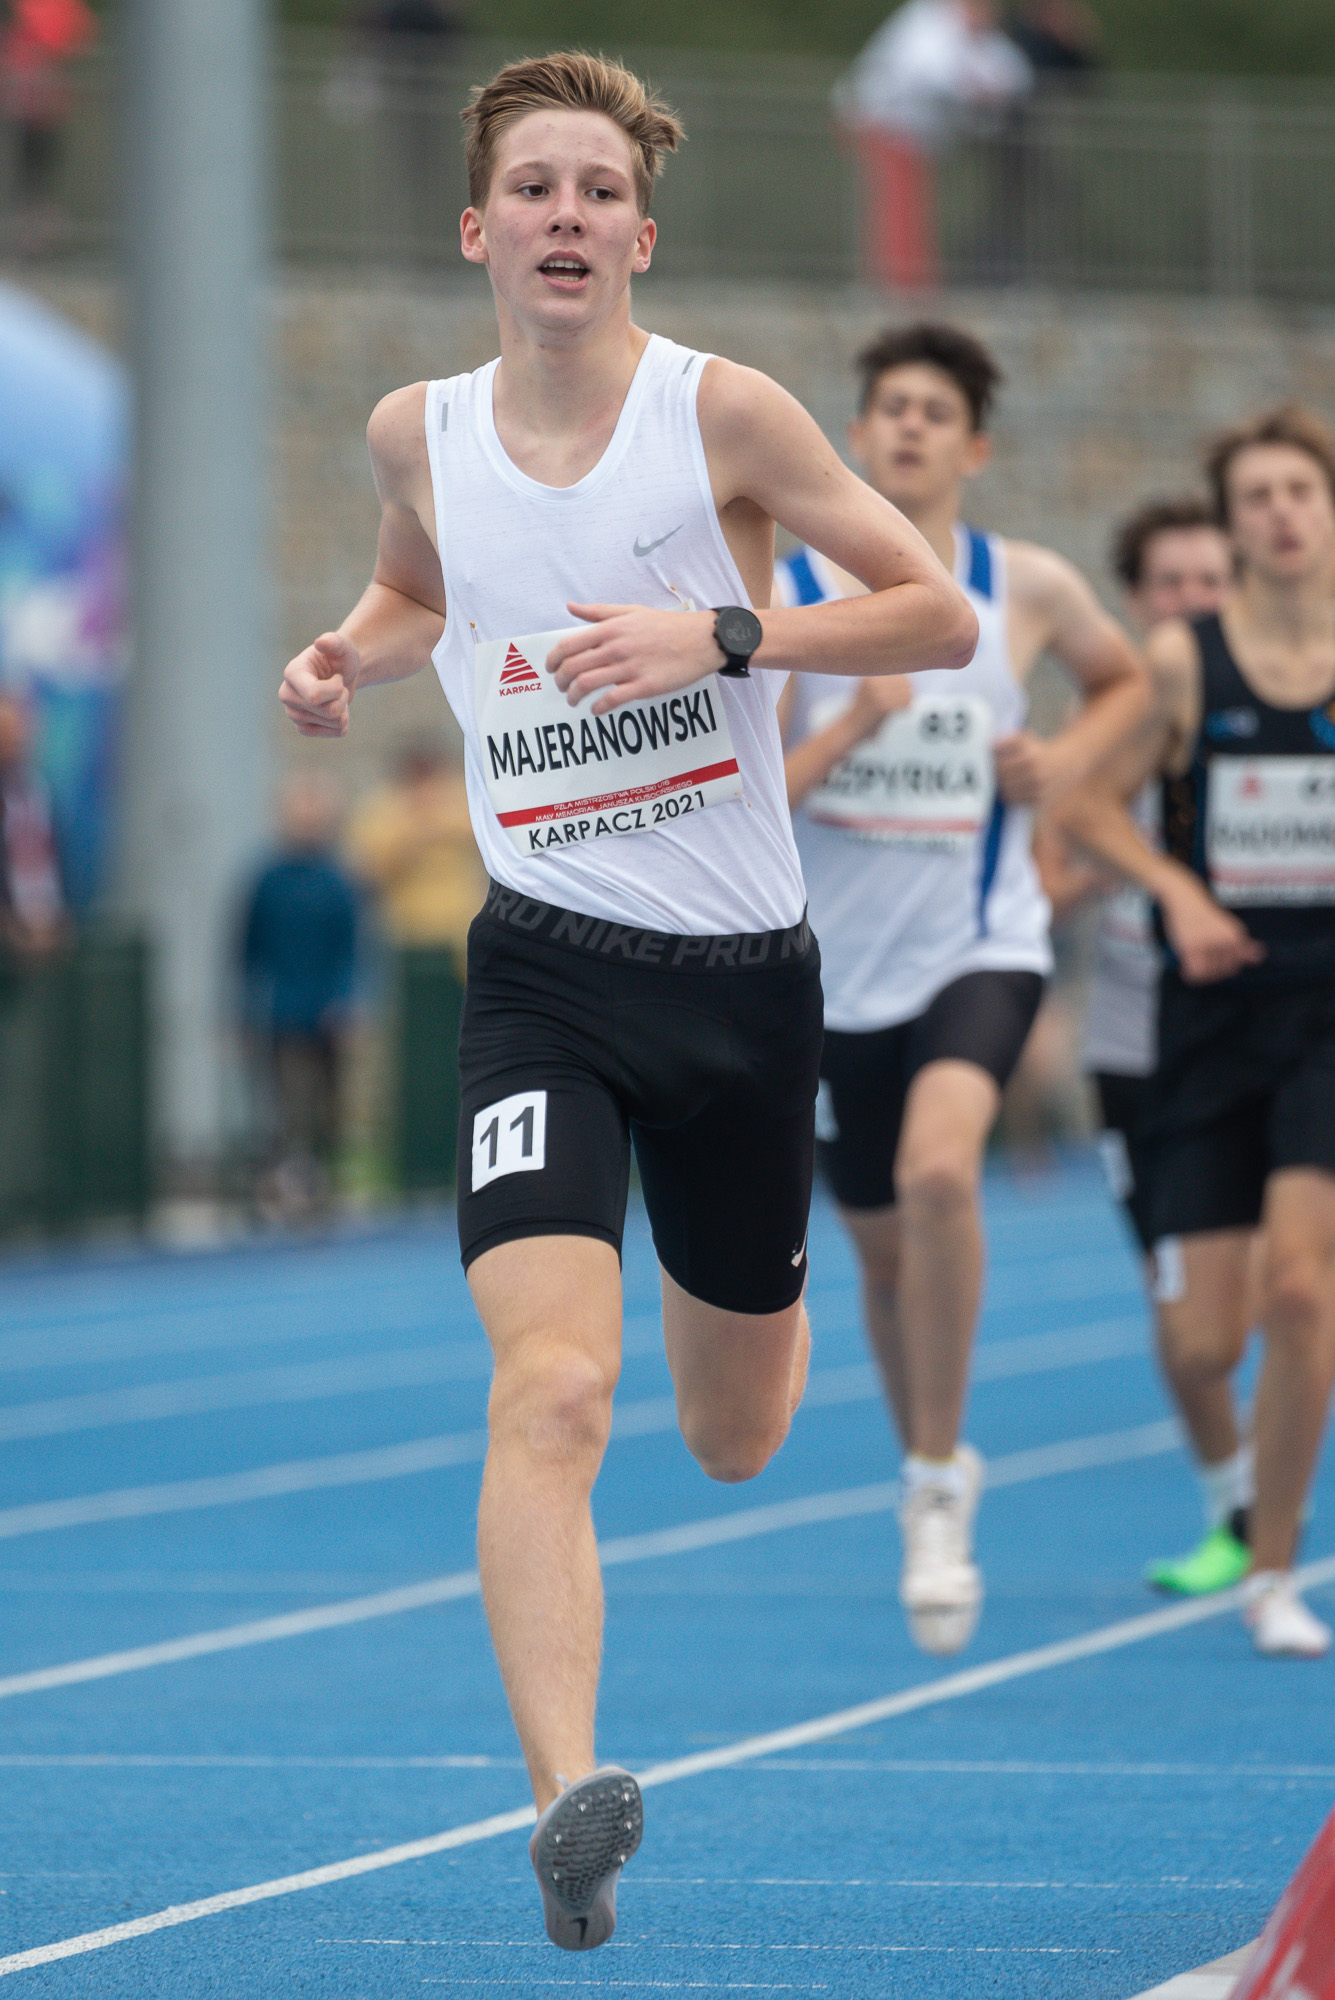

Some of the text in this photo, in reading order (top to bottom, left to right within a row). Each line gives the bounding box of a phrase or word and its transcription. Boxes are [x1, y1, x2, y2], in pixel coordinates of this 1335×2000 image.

[499, 682, 542, 697] KARPACZ
[486, 688, 718, 780] MAJERANOWSKI
[528, 790, 706, 851] KARPACZ 2021
[553, 780, 671, 811] PZLA MISTRZOSTWA POLSKI U16
[598, 797, 635, 810] JANUSZA
[549, 907, 670, 965] NIKE
[671, 931, 771, 968] PRO
[479, 1104, 535, 1170] 11
